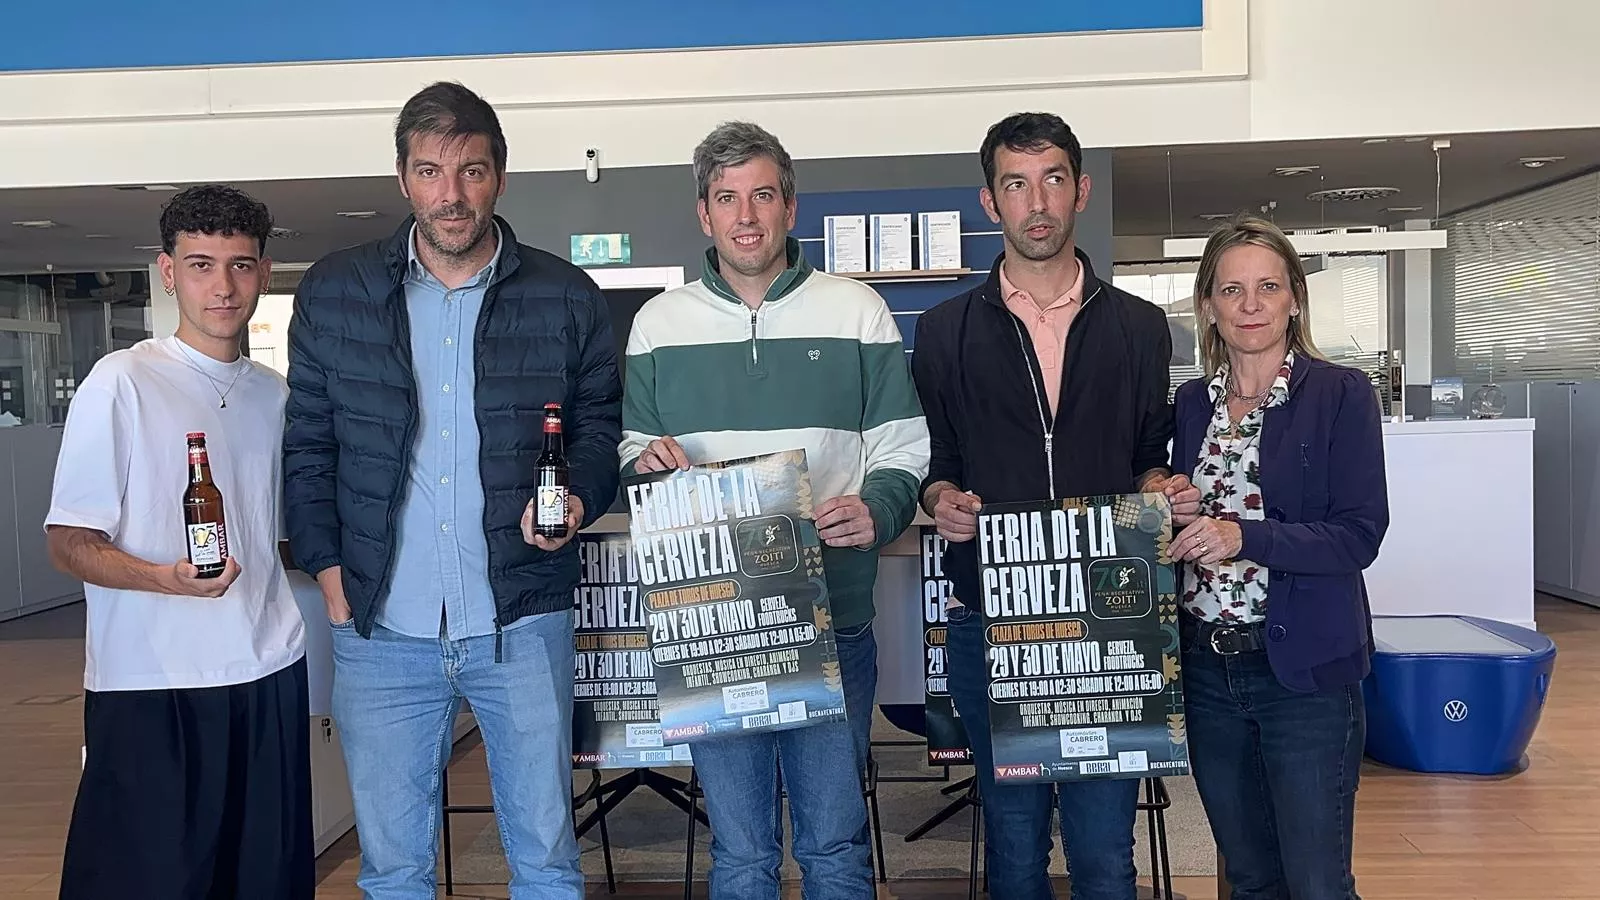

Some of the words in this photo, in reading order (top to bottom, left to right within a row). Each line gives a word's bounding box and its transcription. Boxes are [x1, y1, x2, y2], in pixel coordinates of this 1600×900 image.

[627, 478, 695, 534] FERIA
[696, 472, 728, 524] DE
[730, 467, 761, 518] LA
[217, 523, 228, 560] AMBAR
[979, 511, 1046, 564] FERIA
[1051, 508, 1082, 559] DE
[1087, 506, 1117, 557] LA
[636, 525, 738, 585] CERVEZA
[649, 592, 671, 609] PLAZA
[670, 590, 679, 606] DE
[679, 586, 700, 604] TOROS
[700, 585, 710, 601] DE
[709, 582, 736, 600] HUESCA
[983, 562, 1087, 618] CERVEZA
[760, 595, 789, 612] CERVEZA,
[1105, 595, 1136, 605] ZOITI
[649, 612, 669, 643] 29
[668, 611, 678, 640] Y
[679, 608, 700, 639] 30
[699, 605, 718, 636] DE
[717, 599, 756, 633] MAYO
[758, 607, 797, 627] FOODTRUCKS
[991, 625, 1013, 643] PLAZA
[1013, 624, 1022, 641] DE
[1022, 623, 1045, 640] TOROS
[1045, 622, 1054, 639] DE
[1054, 621, 1082, 638] HUESCA
[653, 645, 681, 663] VIERNES
[680, 643, 690, 659] DE
[689, 641, 709, 657] 19:00
[709, 639, 715, 655] A
[714, 637, 734, 654] 02:30
[734, 633, 761, 651] SÁBADO
[760, 631, 769, 647] DE
[769, 629, 788, 646] 12:00
[788, 627, 795, 643] A
[794, 624, 815, 641] 03:00
[1107, 640, 1137, 655] CERVEZA,
[587, 652, 595, 678] Y
[597, 652, 613, 678] 30
[615, 651, 629, 678] DE
[630, 651, 654, 677] MAY
[736, 657, 744, 669] EN
[769, 649, 800, 664] ANIMACIÓN
[782, 662, 787, 674] Y
[927, 647, 944, 675] 29
[989, 646, 1009, 678] 29
[1010, 645, 1019, 676] Y
[1021, 644, 1041, 676] 30
[1042, 643, 1060, 675] DE
[1061, 641, 1101, 673] MAYO
[1103, 654, 1145, 670] FOODTRUCKS
[594, 682, 602, 696] DE
[602, 682, 618, 696] 19:00
[619, 682, 624, 695] A
[624, 681, 641, 695] 02:30
[732, 689, 765, 699] CABRERO
[991, 682, 1019, 699] VIERNES
[1020, 681, 1029, 697] DE
[1029, 680, 1049, 696] 19:00
[1049, 679, 1055, 695] A
[1055, 678, 1076, 695] 02:30
[1076, 676, 1104, 694] SÁBADO
[1104, 676, 1113, 692] DE
[1114, 675, 1134, 692] 12:00
[1134, 674, 1140, 691] A
[1140, 673, 1162, 690] 03:00
[808, 707, 844, 718] BUENAVENTURA
[1020, 702, 1053, 715] ORQUESTAS,
[1077, 700, 1085, 712] EN
[1085, 699, 1111, 711] DIRECTO,
[1111, 697, 1143, 710] ANIMACIÓN
[1022, 715, 1049, 727] INFANTIL,
[1125, 710, 1129, 722] Y
[673, 725, 704, 737] AMBAR
[579, 754, 606, 762] AMBAR
[937, 750, 964, 759] AMBAR
[1007, 767, 1038, 776] AMBAR
[1150, 761, 1187, 769] BUENAVENTURA
